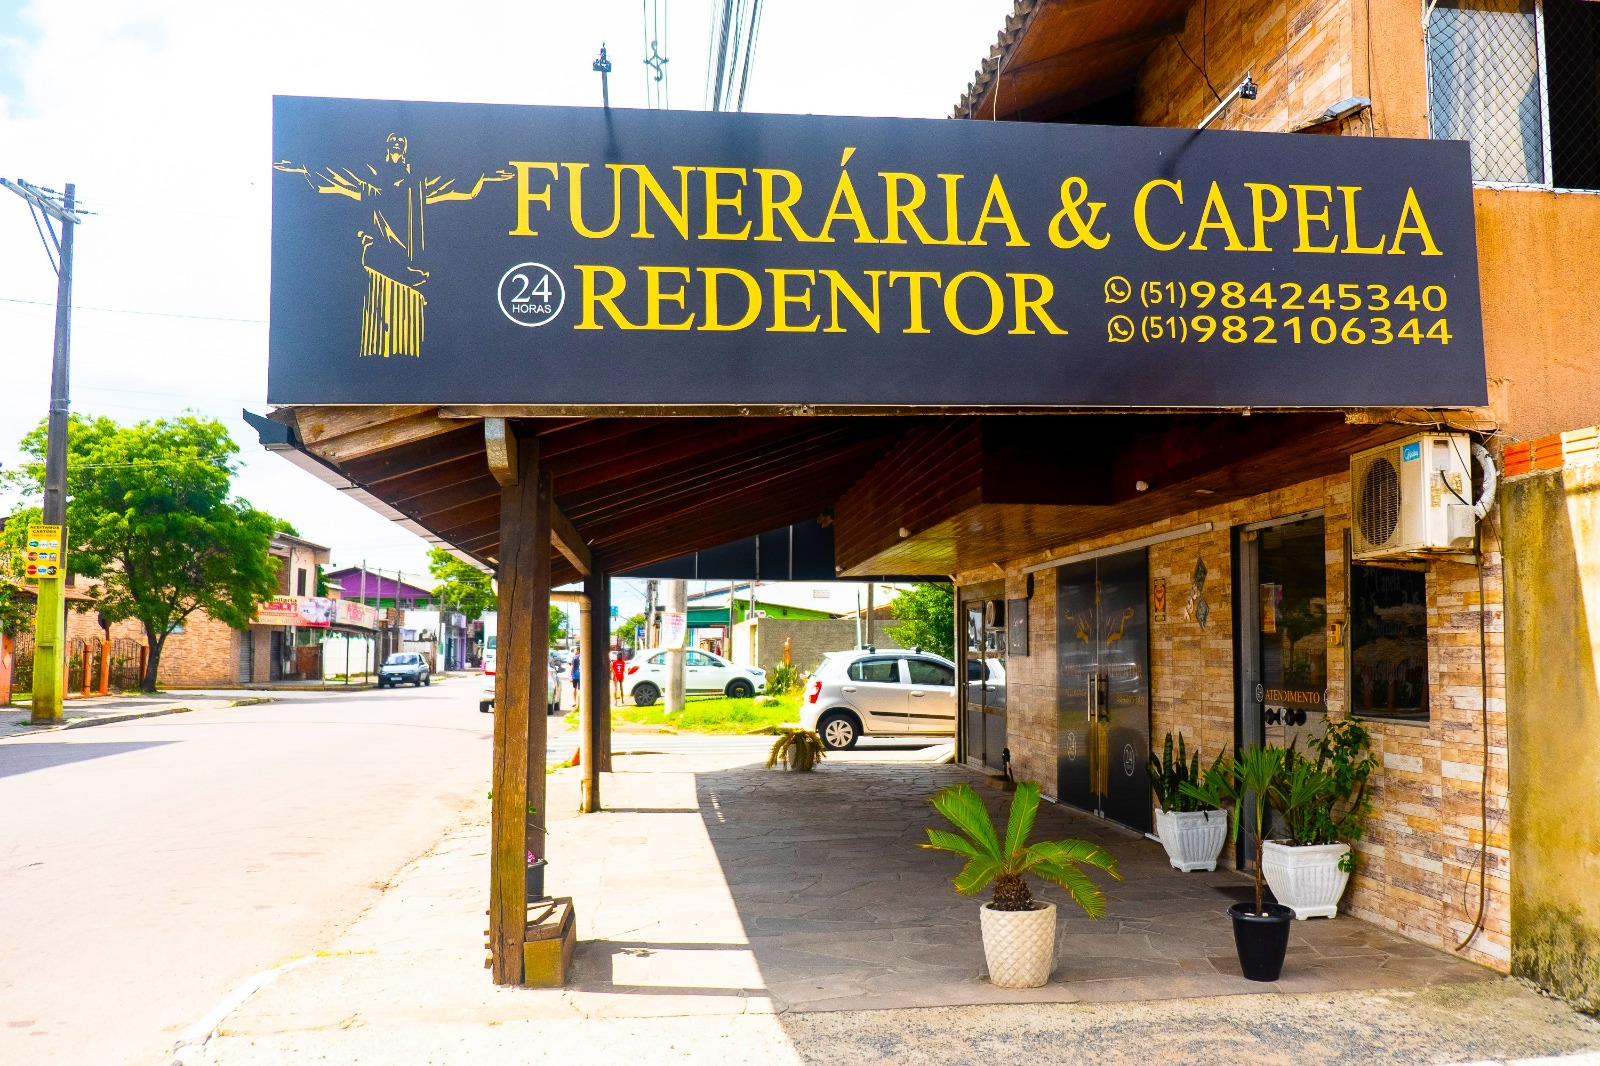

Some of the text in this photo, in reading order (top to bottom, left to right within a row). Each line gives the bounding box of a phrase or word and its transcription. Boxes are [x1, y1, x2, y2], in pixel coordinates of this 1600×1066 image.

[508, 147, 1444, 257] FUNERÁRIA & CAPELA
[511, 273, 553, 303] 24
[573, 264, 1069, 336] REDENTOR
[512, 303, 552, 314] HORAS
[1266, 689, 1320, 704] ATENDIMENTO
